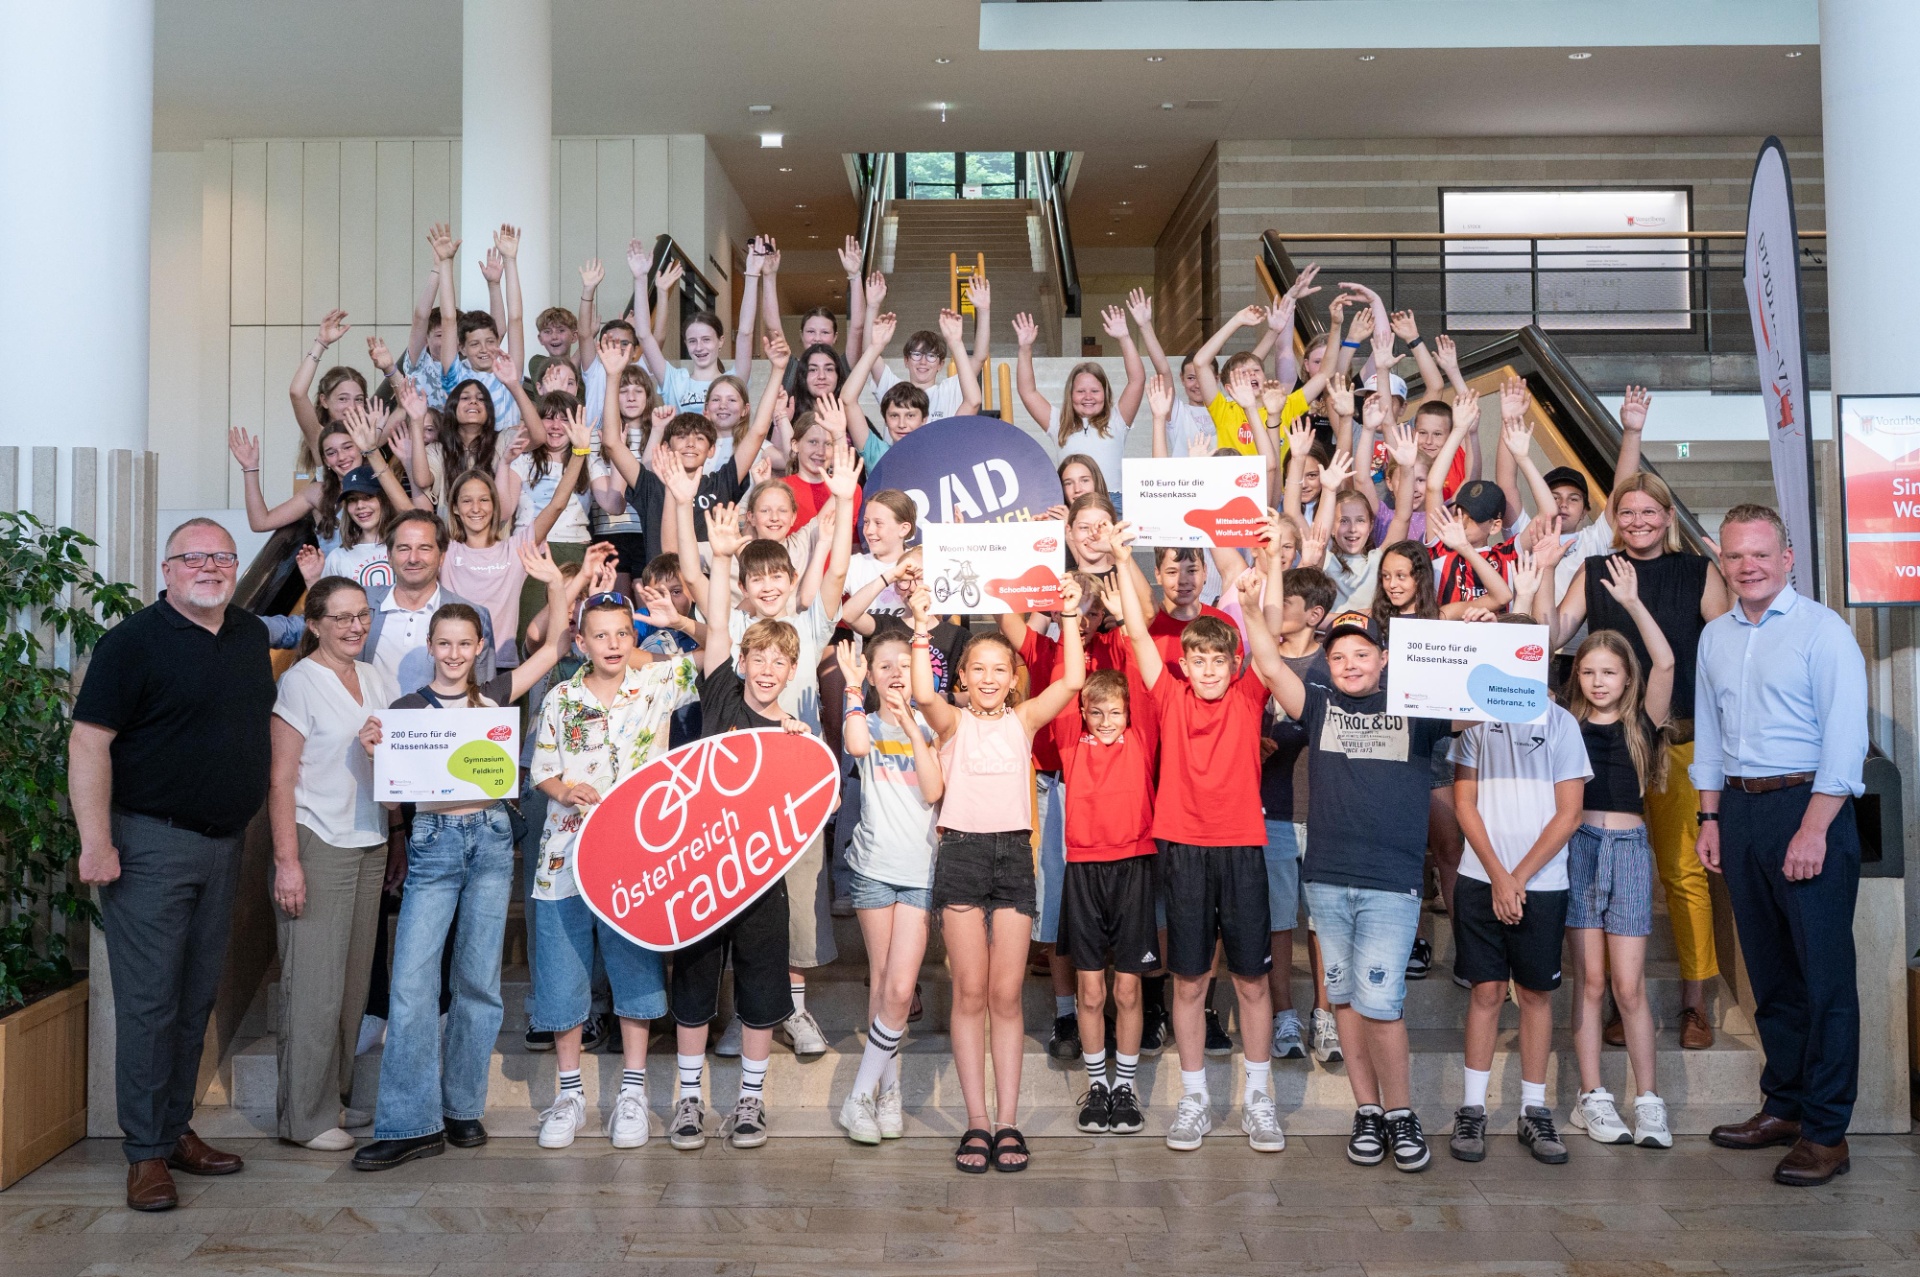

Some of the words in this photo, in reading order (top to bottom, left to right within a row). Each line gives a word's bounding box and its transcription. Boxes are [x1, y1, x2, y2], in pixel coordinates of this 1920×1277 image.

[1156, 479, 1176, 487] Euro
[1178, 478, 1190, 487] für
[1191, 478, 1205, 486] die
[1139, 490, 1197, 498] Klassenkassa
[1892, 500, 1920, 518] We
[1215, 529, 1243, 538] Wolfurt,
[989, 544, 1007, 552] Bike
[999, 585, 1040, 594] Schoolbiker
[1407, 642, 1423, 650] 300
[1425, 643, 1446, 651] Euro
[1448, 644, 1461, 652] für
[1463, 644, 1477, 653] die
[1406, 654, 1468, 665] Klassenkassa
[940, 660, 949, 688] TIMES
[1488, 685, 1535, 695] Mittelschule
[1487, 698, 1524, 707] Hörbranz,
[408, 730, 428, 738] Euro
[430, 730, 441, 738] für
[444, 730, 457, 738] die
[463, 756, 505, 765] Gymnasium
[611, 807, 741, 919] Österreich
[664, 788, 812, 945] radelt
